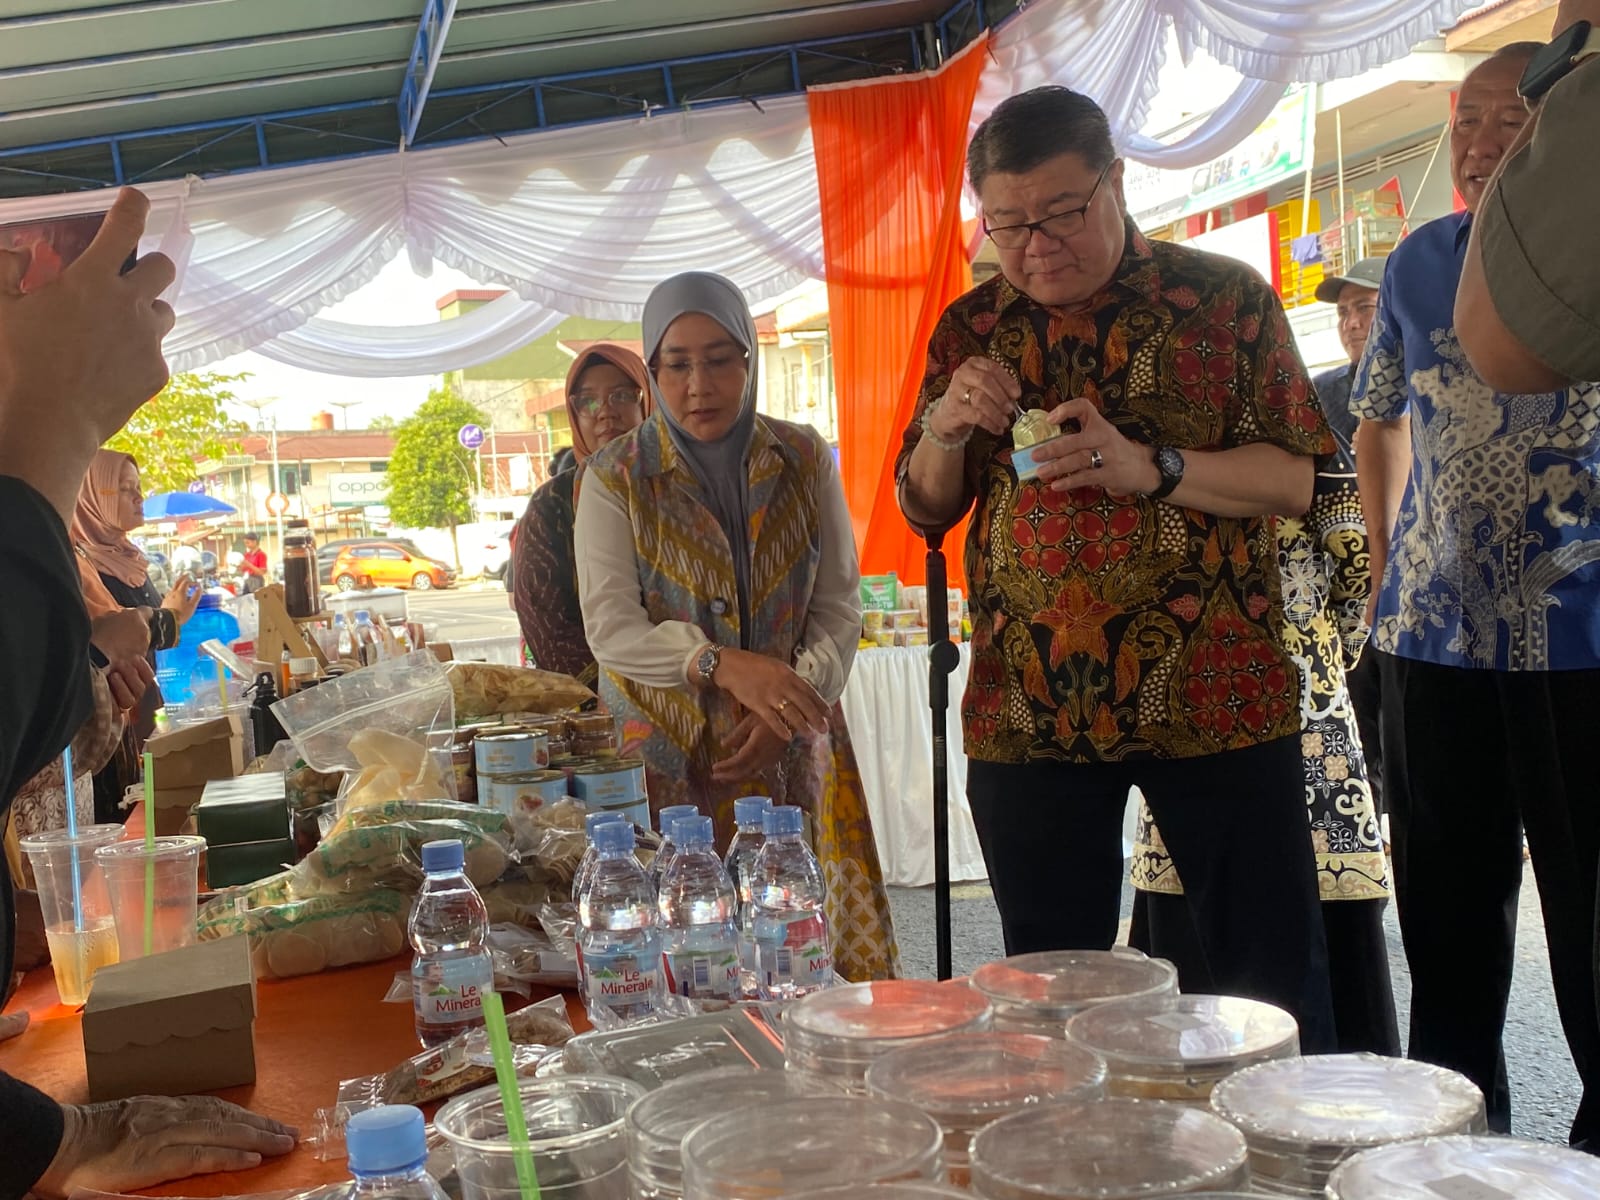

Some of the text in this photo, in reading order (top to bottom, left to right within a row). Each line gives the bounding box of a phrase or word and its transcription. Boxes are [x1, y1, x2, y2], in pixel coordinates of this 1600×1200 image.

[624, 968, 640, 982] Le
[461, 984, 477, 998] Le
[601, 977, 654, 995] Minerale
